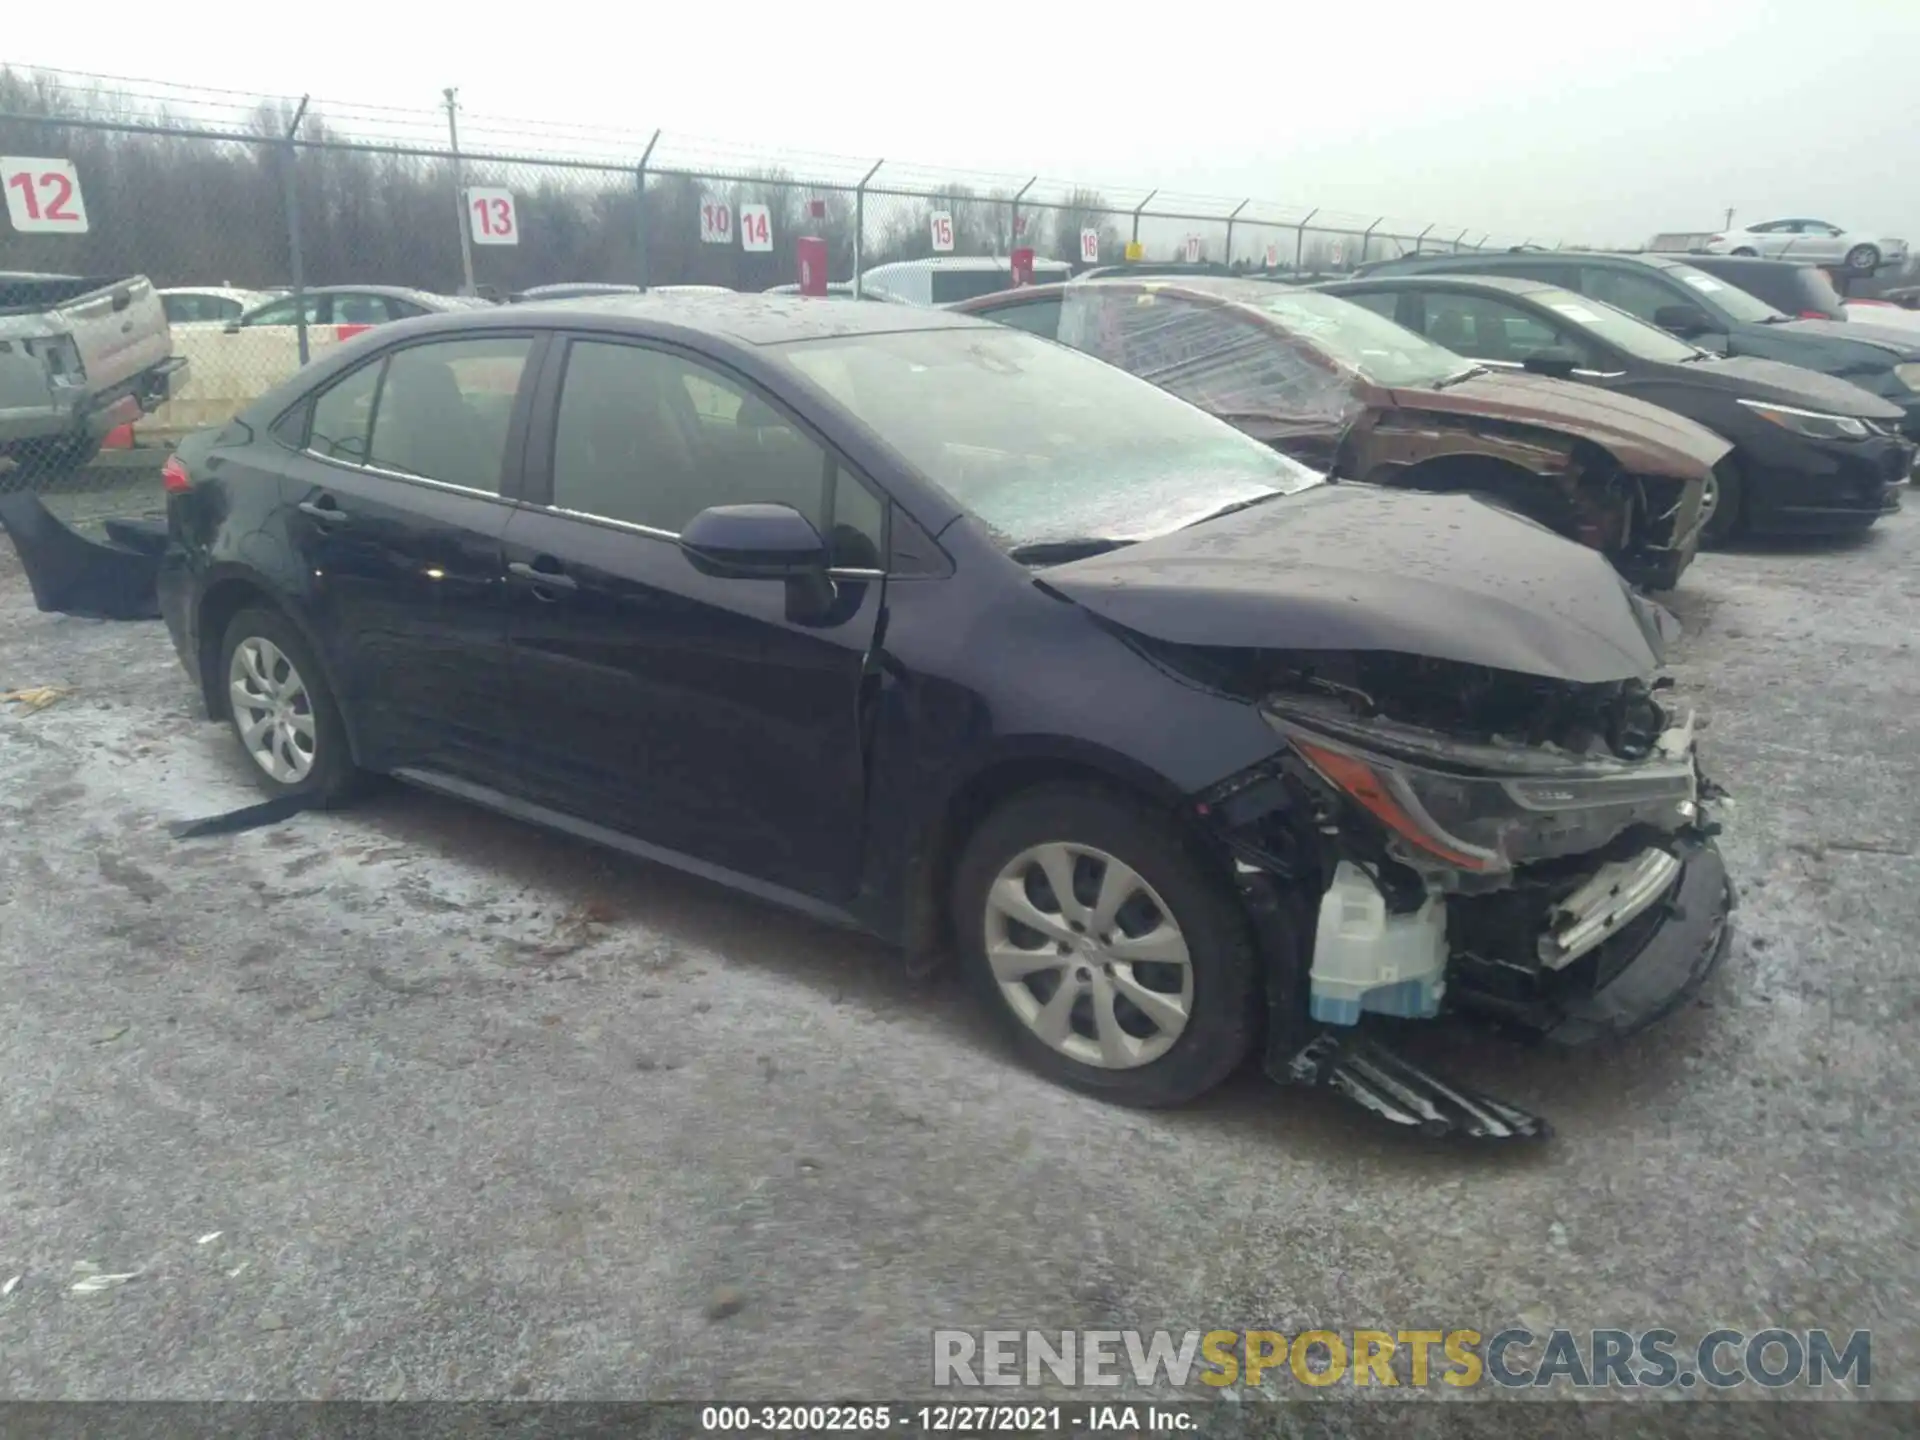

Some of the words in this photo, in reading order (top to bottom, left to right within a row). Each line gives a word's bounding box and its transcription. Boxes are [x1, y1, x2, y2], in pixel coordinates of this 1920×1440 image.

[9, 172, 80, 220] 12
[473, 198, 512, 235] 13
[703, 204, 729, 233] 10
[743, 212, 769, 244] 14
[932, 219, 952, 244] 15
